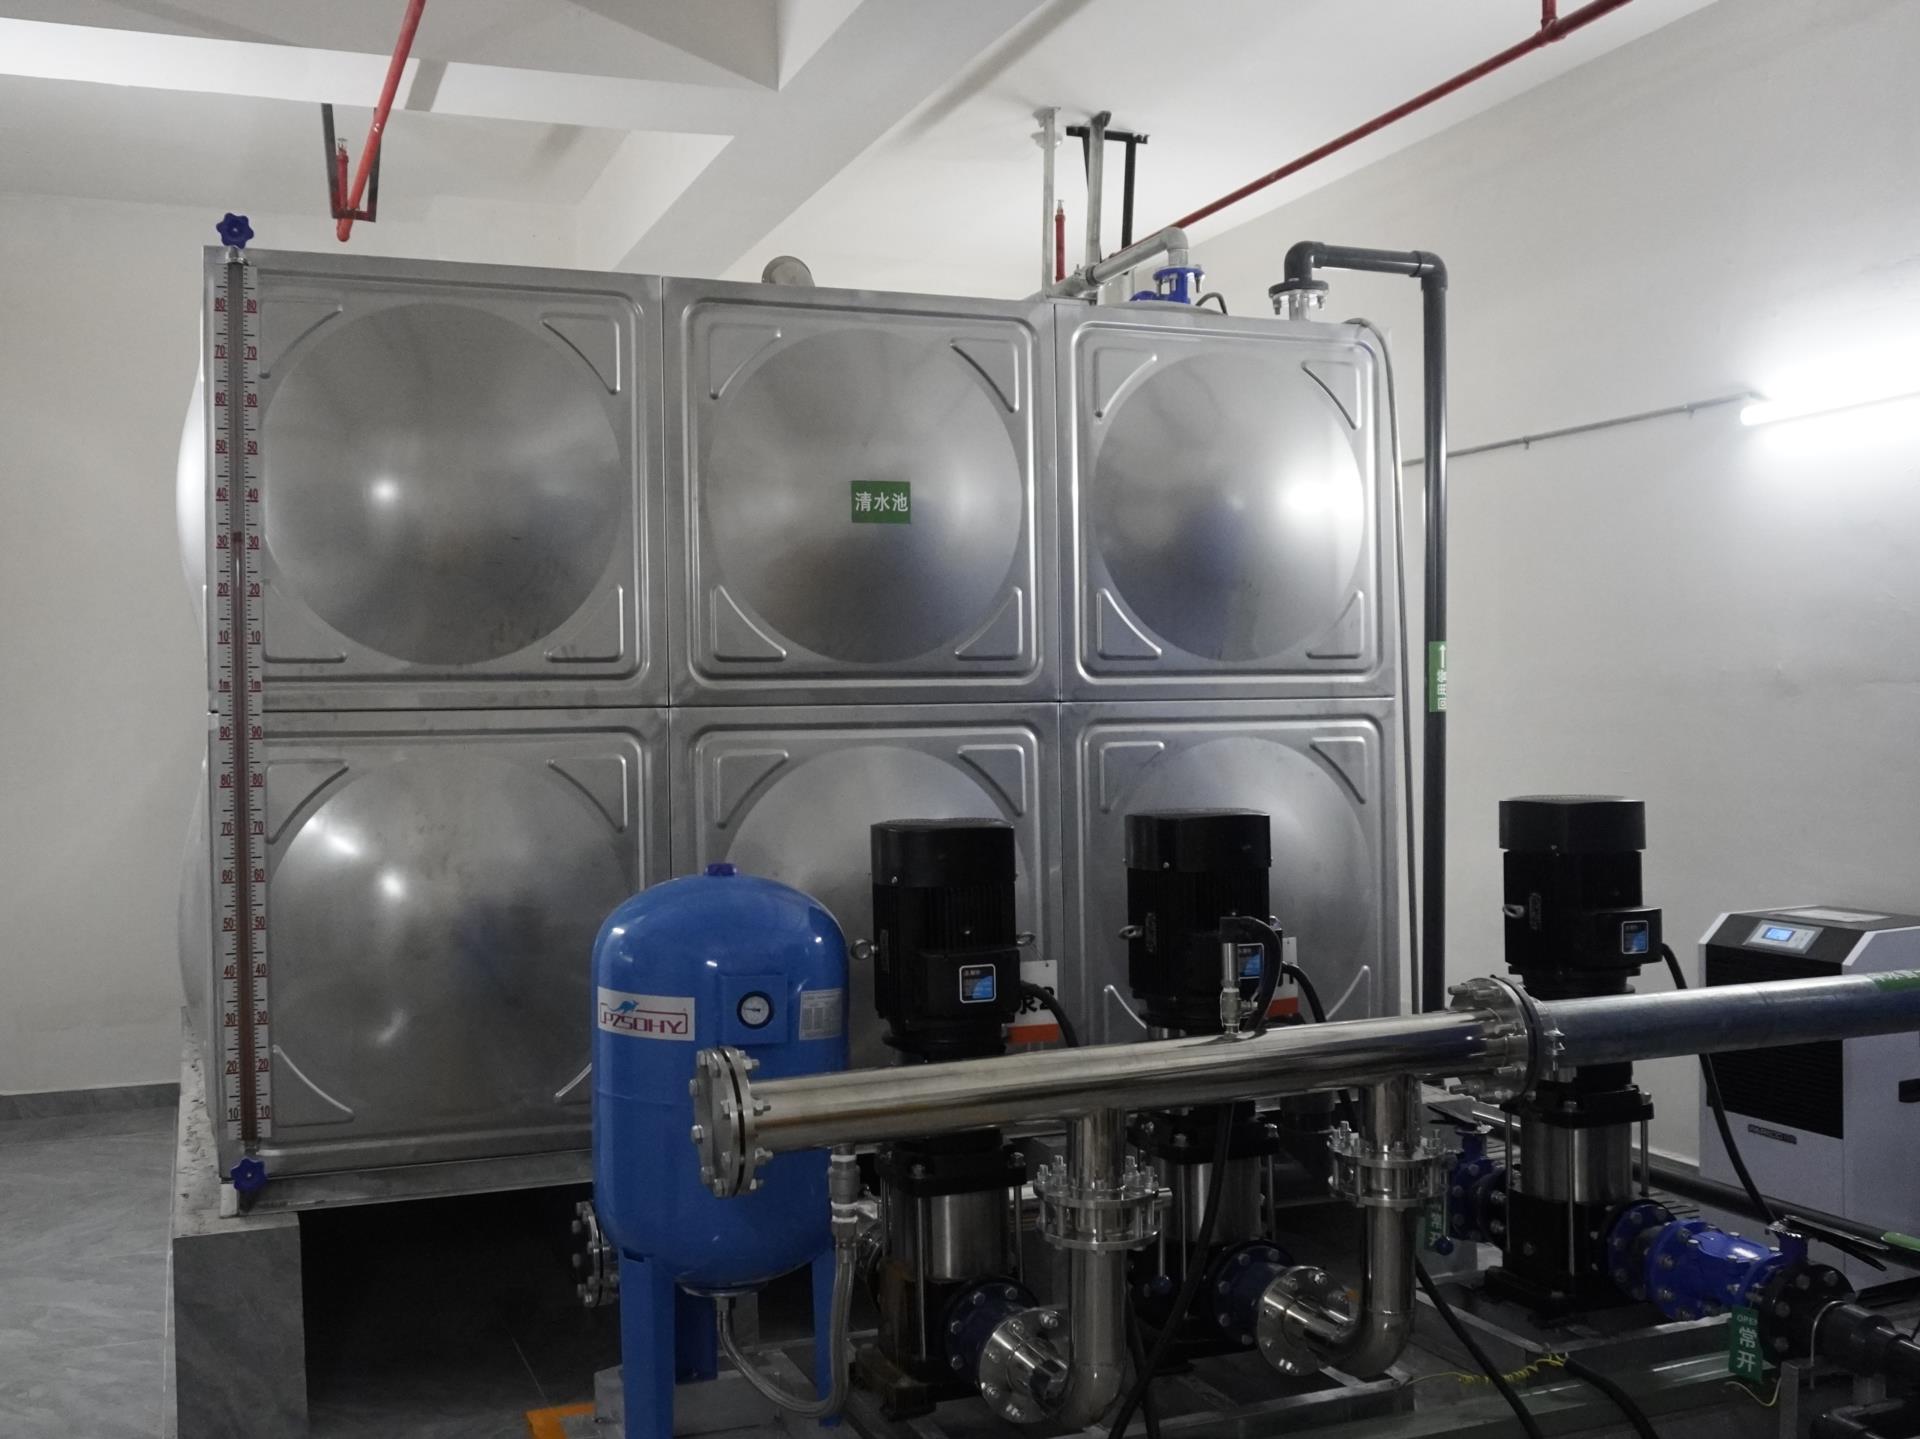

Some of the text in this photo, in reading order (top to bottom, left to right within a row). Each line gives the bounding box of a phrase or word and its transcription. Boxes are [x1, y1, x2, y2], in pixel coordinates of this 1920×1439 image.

[215, 298, 225, 310] 80
[247, 300, 257, 312] 80
[215, 345, 225, 357] 70
[247, 346, 257, 358] 70
[215, 393, 226, 404] 60
[247, 394, 257, 406] 60
[216, 440, 226, 452] 50
[247, 441, 258, 453] 50
[216, 488, 227, 499] 40
[248, 489, 258, 500] 40
[855, 491, 909, 512] 清水池
[217, 535, 227, 547] 30
[249, 536, 259, 548] 30
[218, 583, 229, 595] 20
[250, 583, 261, 595] 20
[219, 631, 229, 642] 10
[251, 631, 261, 642] 10
[220, 726, 230, 738] 90
[251, 726, 262, 737] 90
[221, 774, 231, 786] 80
[252, 774, 263, 785] 80
[222, 822, 232, 834] 70
[253, 821, 263, 833] 70
[222, 870, 233, 881] 60
[254, 869, 265, 881] 60
[223, 918, 233, 929] 50
[255, 916, 265, 928] 50
[224, 965, 235, 977] 40
[256, 964, 266, 975] 40
[225, 1013, 235, 1025] 30
[257, 1011, 268, 1023] 30
[227, 1061, 237, 1072] 20
[258, 1059, 269, 1071] 20
[229, 1108, 239, 1120] 10
[260, 1105, 270, 1118] 10
[1736, 1326, 1758, 1374] 常开
